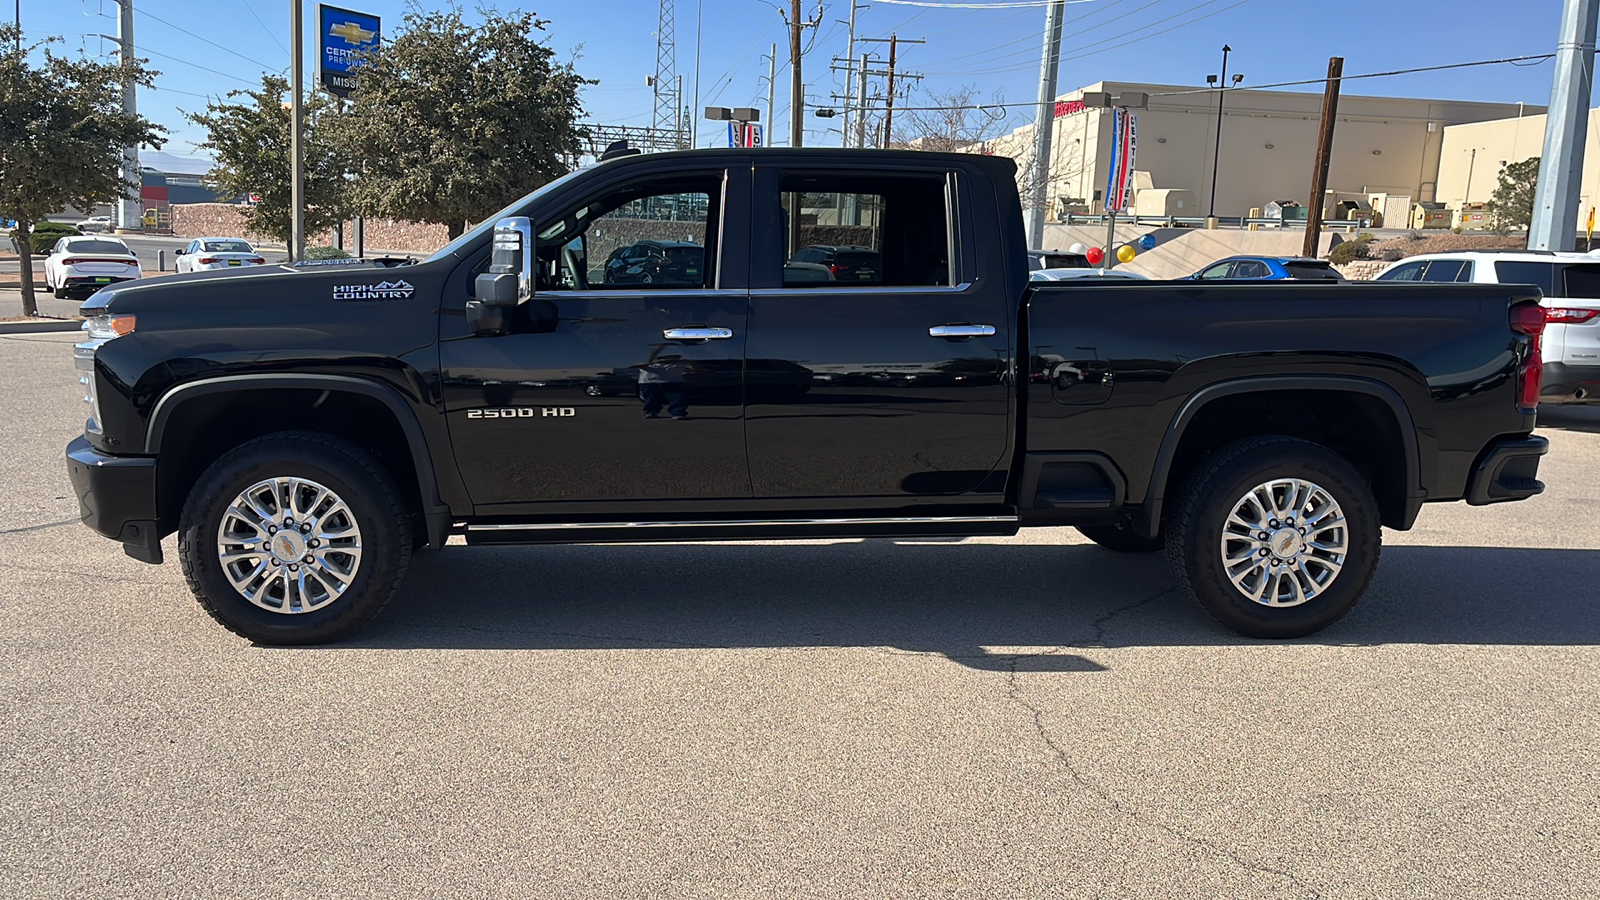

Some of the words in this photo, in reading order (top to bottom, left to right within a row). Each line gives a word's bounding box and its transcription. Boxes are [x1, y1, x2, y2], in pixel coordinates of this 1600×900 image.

[333, 76, 361, 89] MISSI
[753, 127, 761, 148] LO
[1122, 115, 1137, 208] CERTIFIED
[333, 285, 374, 293] HIGH
[333, 291, 413, 300] COUNTRY
[467, 408, 534, 419] 2500
[541, 407, 575, 417] HD
